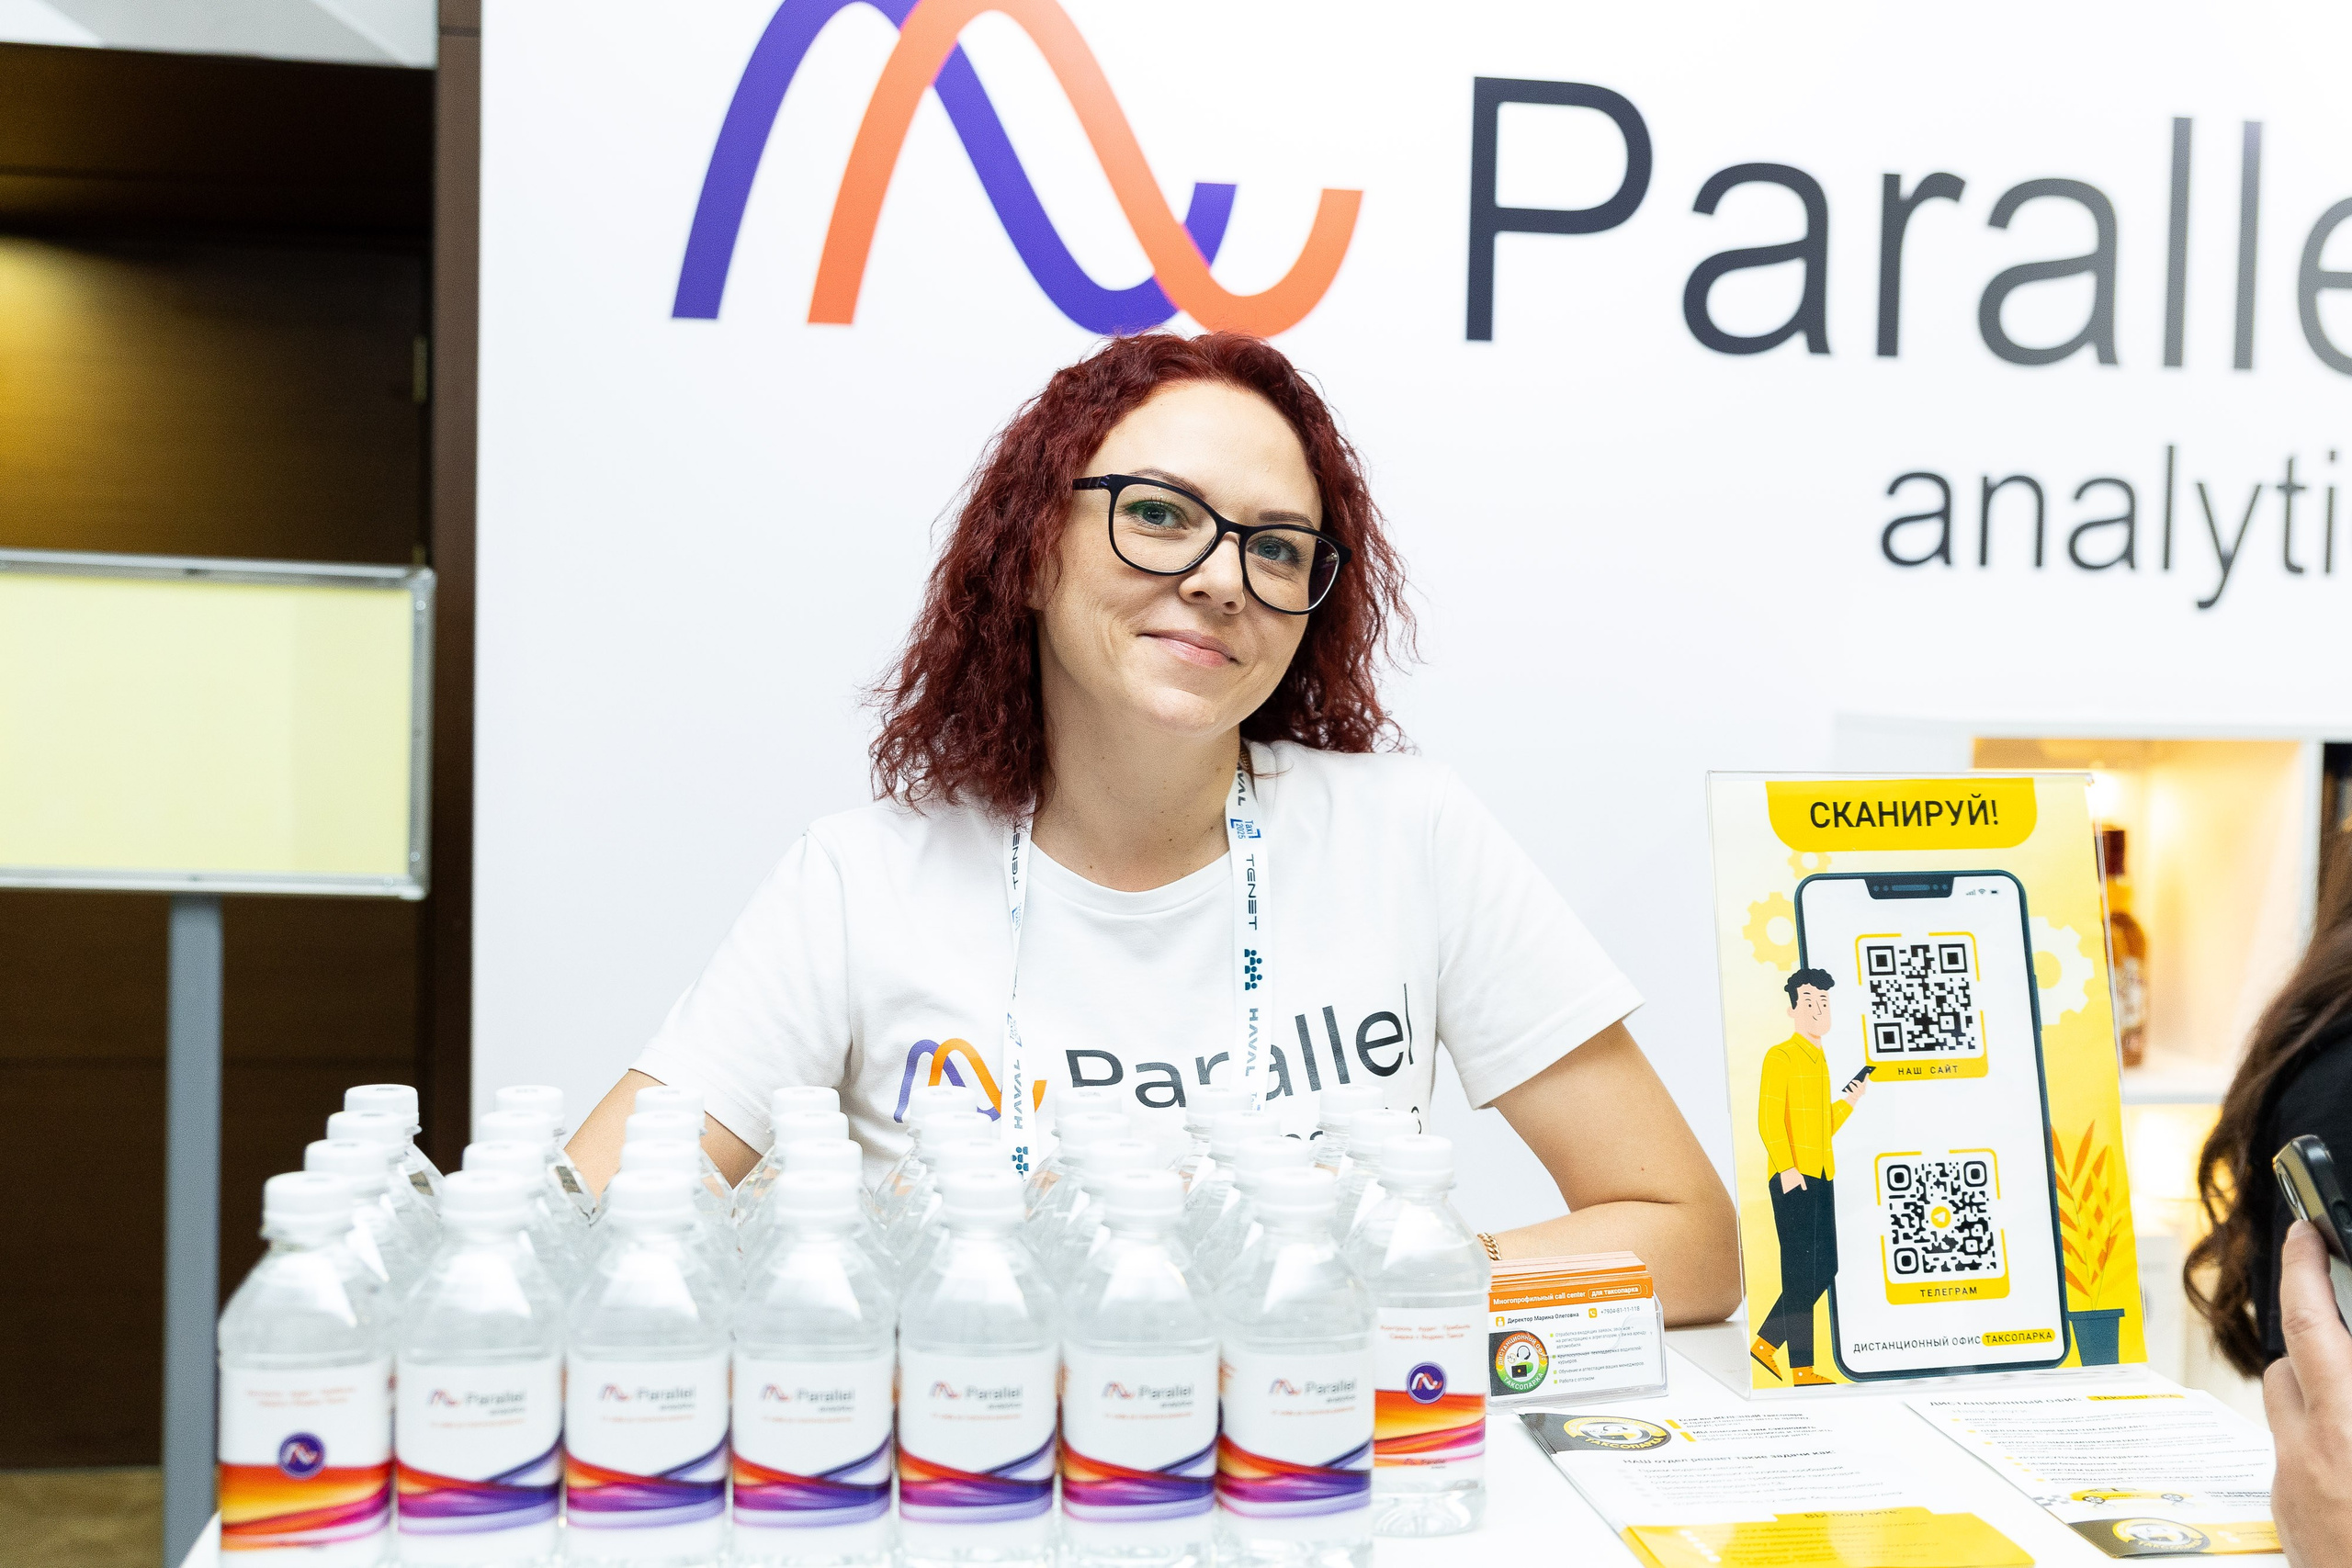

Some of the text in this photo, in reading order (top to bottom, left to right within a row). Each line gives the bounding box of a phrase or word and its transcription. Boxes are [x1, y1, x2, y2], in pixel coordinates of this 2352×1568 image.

[1810, 794, 1999, 829] СКАНИРУЙ!
[1236, 823, 1246, 839] 2025
[1245, 820, 1253, 834] Taxi
[1245, 1008, 1259, 1077] HAVAL
[1897, 1064, 1958, 1076] НАШ САЙТ
[1013, 1059, 1023, 1130] HAVAL
[1493, 1286, 1639, 1305] Многопрофильный call center для таксопарка
[1919, 1286, 1978, 1297] ТЕЛЕГРАМ
[1508, 1315, 1533, 1325] Директор
[1534, 1314, 1555, 1323] Марина
[1555, 1312, 1579, 1320] Олеговна
[1853, 1331, 2052, 1354] ДИСТАНЦИОННЫЙ ОФИС ТАКСОПАРКА
[1504, 1373, 1544, 1390] ТАКСОПАРКА
